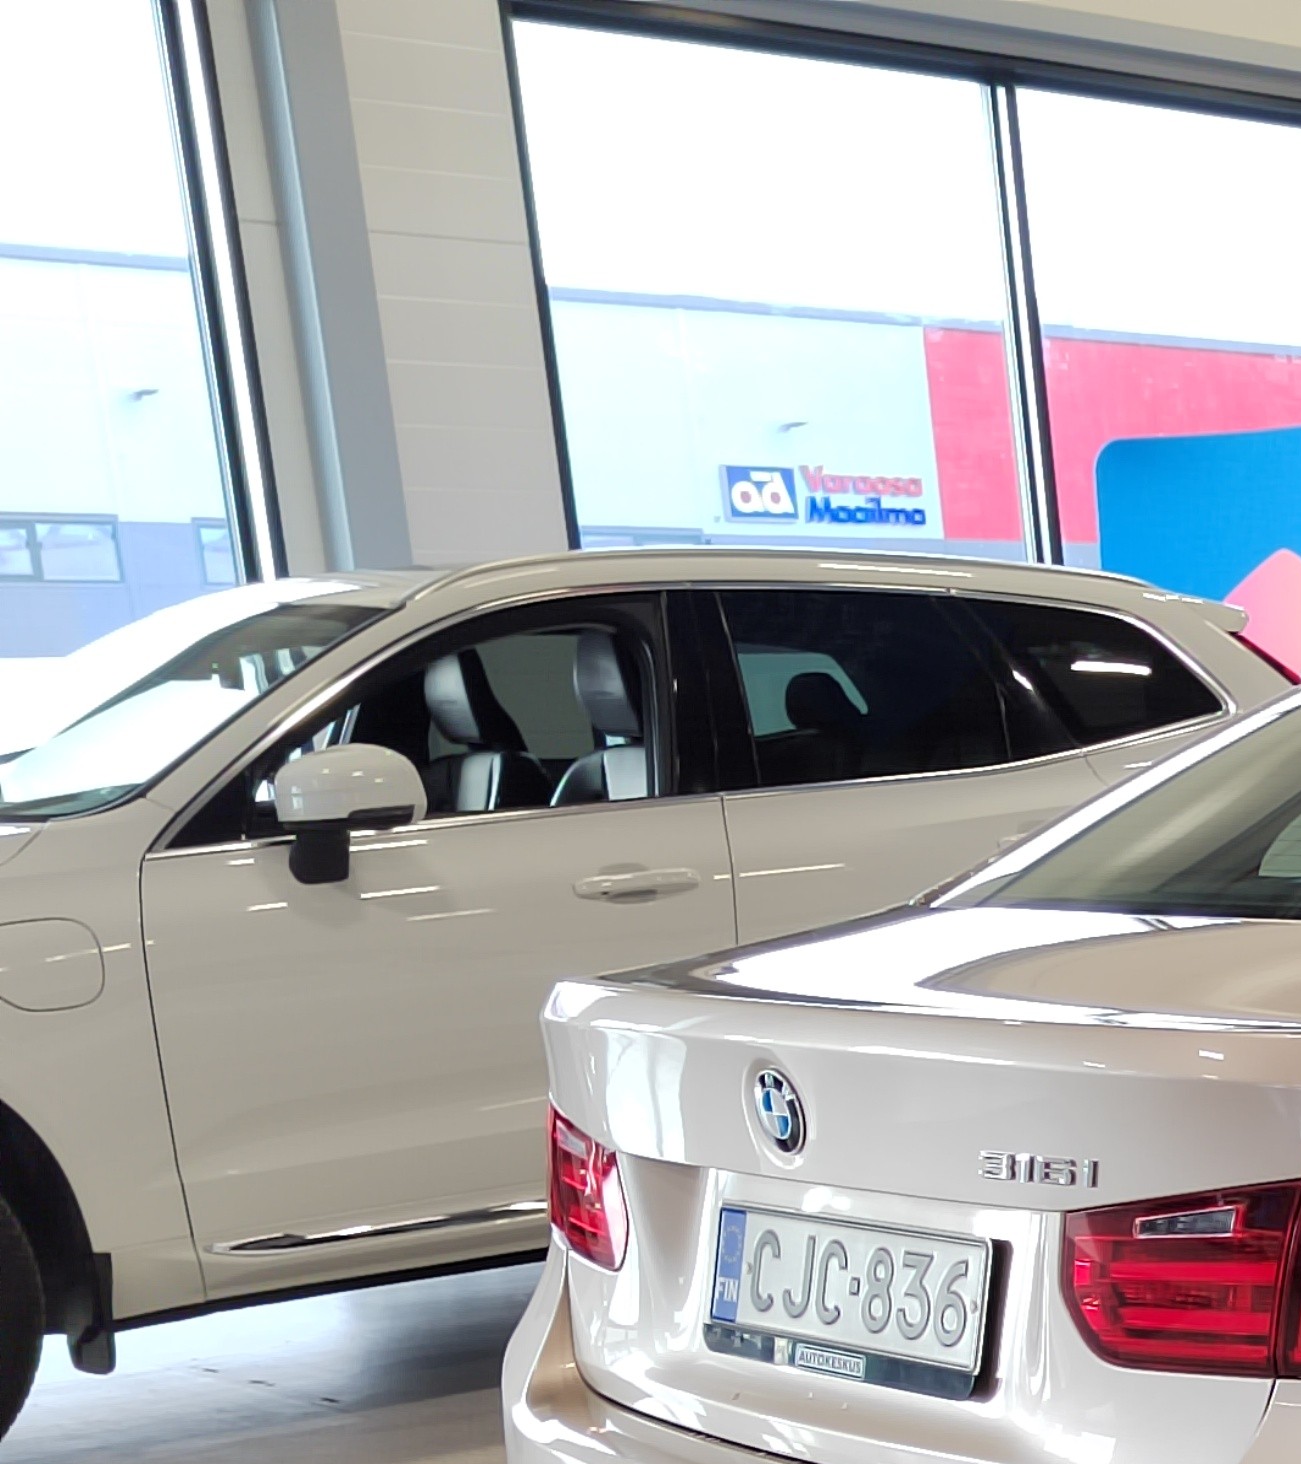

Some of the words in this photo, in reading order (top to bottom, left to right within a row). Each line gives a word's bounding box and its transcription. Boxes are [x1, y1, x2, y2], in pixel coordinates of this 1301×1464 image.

[805, 496, 926, 525] Maailma
[715, 1277, 738, 1303] FIN
[751, 1229, 968, 1347] CJC-836
[799, 1349, 861, 1376] AUTOKESKUS
